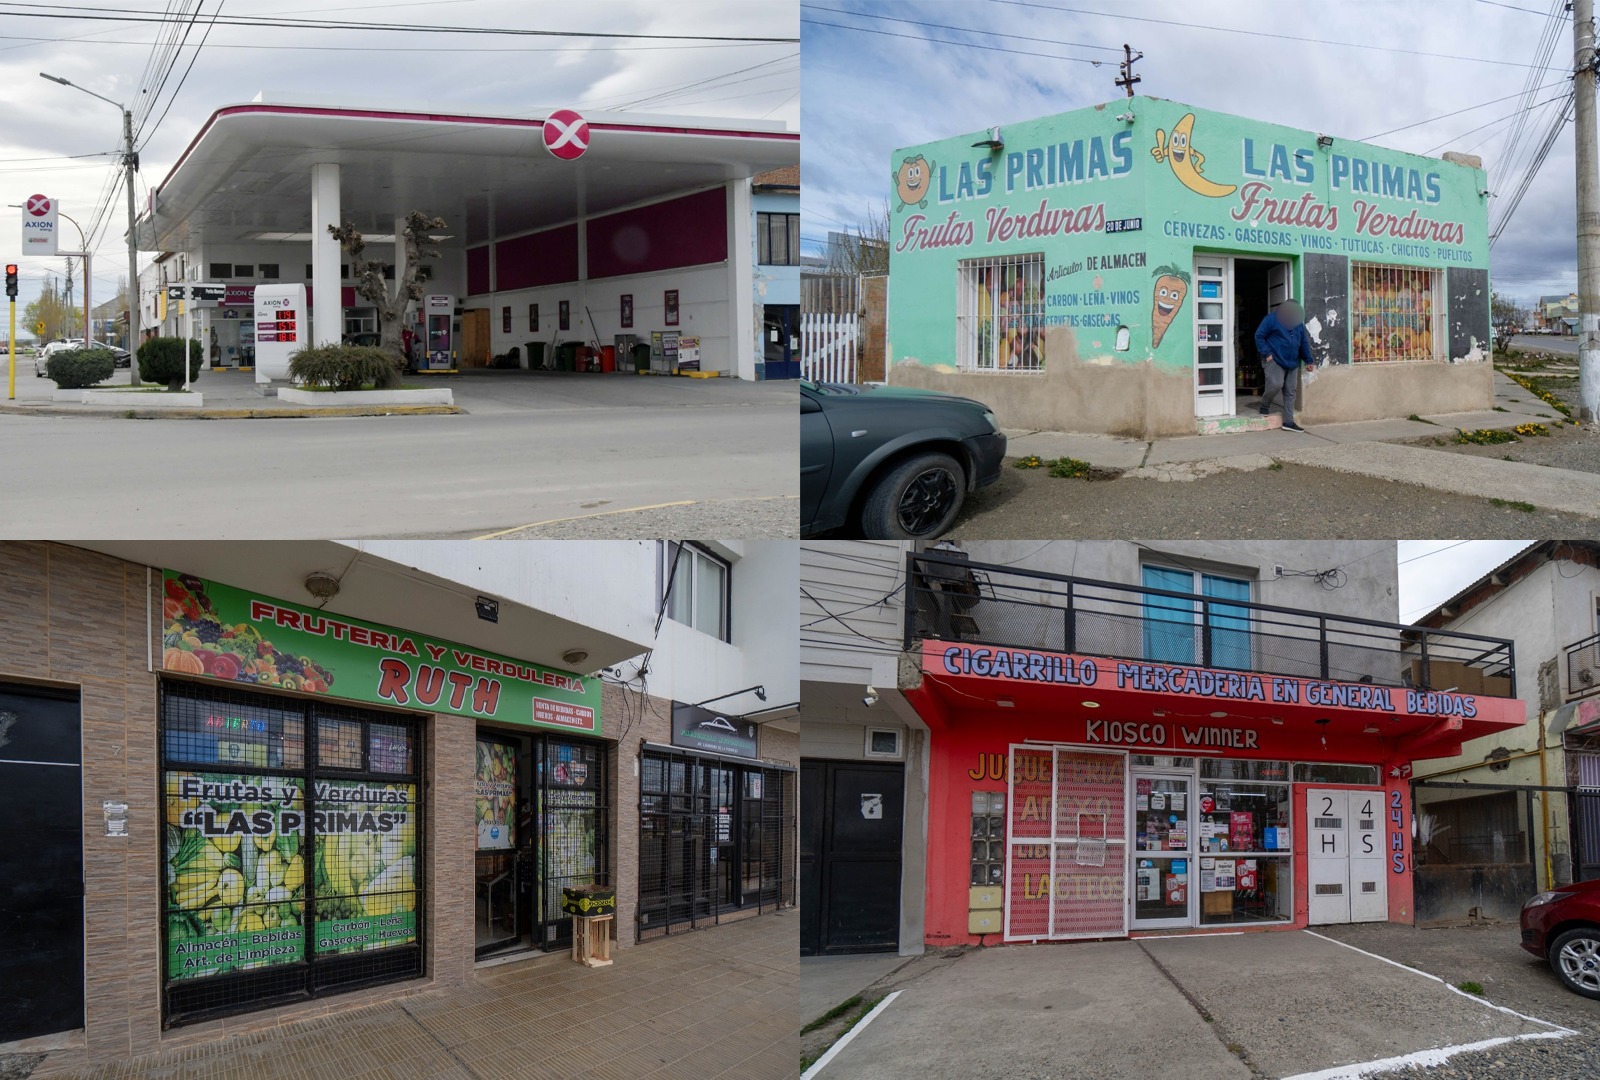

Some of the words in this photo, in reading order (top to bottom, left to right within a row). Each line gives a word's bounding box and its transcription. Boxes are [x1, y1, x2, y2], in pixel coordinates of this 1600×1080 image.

[938, 157, 993, 205] LAS
[1005, 129, 1133, 195] PRIMAS
[1242, 137, 1315, 187] LAS
[1330, 153, 1441, 206] PRIMAS
[895, 210, 974, 253] Frutas
[986, 199, 1105, 244] Verduras
[1106, 221, 1115, 231] 20
[1115, 220, 1123, 231] DE
[1122, 218, 1140, 230] JUNIO
[1231, 182, 1338, 231] Frutas
[1353, 199, 1464, 245] Verduras
[1163, 220, 1225, 241] CERVEZAS
[1234, 227, 1292, 247] GASEOSAS
[1300, 234, 1332, 250] VINOS
[1340, 237, 1384, 254] TUTUCAS
[1391, 242, 1430, 259] CHICITOS
[1046, 262, 1083, 282] Articulos
[1086, 256, 1099, 271] DE
[1100, 252, 1147, 271] ALMACEN
[1046, 293, 1078, 307] CARBON
[1083, 289, 1106, 306] LEÑA
[1110, 290, 1140, 305] VINOS
[251, 600, 420, 656] FRUTERIA
[424, 643, 447, 661] Y
[452, 650, 586, 694] VERDULERIA
[378, 657, 501, 716] RUTH
[943, 647, 1098, 686] CIGARRILLO
[1116, 662, 1265, 701] MERCADERIA
[1272, 676, 1300, 704] EN
[1305, 681, 1396, 712] GENERAL
[1406, 689, 1478, 718] BEBIDAS
[206, 715, 265, 732] ABIERTO
[1086, 719, 1166, 745] KIOSCO
[182, 779, 272, 801] Frutas
[281, 786, 296, 806] y
[311, 783, 408, 803] Verduras
[1322, 797, 1333, 816] 2
[1361, 799, 1373, 818] 4
[1391, 790, 1403, 828] 24
[1321, 834, 1335, 853] H
[1362, 834, 1374, 853] S
[1392, 832, 1405, 874] HS
[1023, 872, 1124, 900] LACTEOS
[319, 933, 369, 948] Gaseosas
[379, 927, 414, 939] Huevos
[332, 920, 370, 933] Carbón
[380, 915, 403, 927] Leña
[175, 937, 238, 954] Almacén
[252, 930, 302, 944] Bebidas
[184, 955, 211, 968] Art.
[216, 951, 233, 963] de
[237, 944, 295, 961] Limpieza
